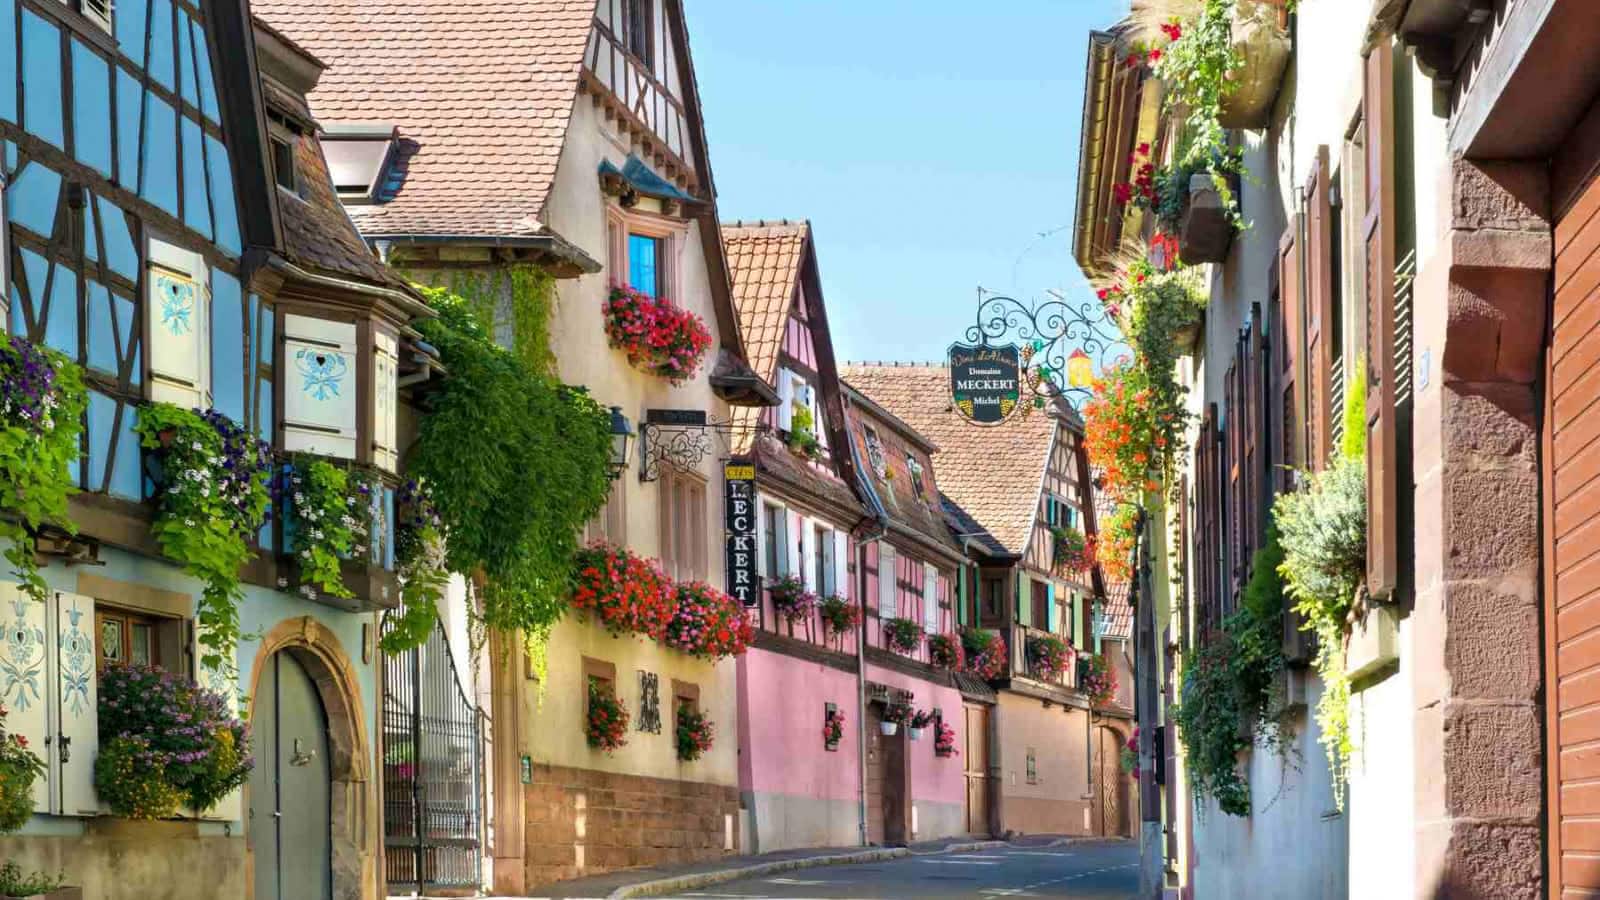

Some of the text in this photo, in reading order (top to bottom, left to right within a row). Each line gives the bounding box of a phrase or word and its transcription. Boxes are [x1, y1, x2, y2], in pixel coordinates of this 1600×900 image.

[968, 367, 1001, 376] Domaine
[957, 380, 1016, 390] MECKERT
[973, 396, 1000, 405] Michel
